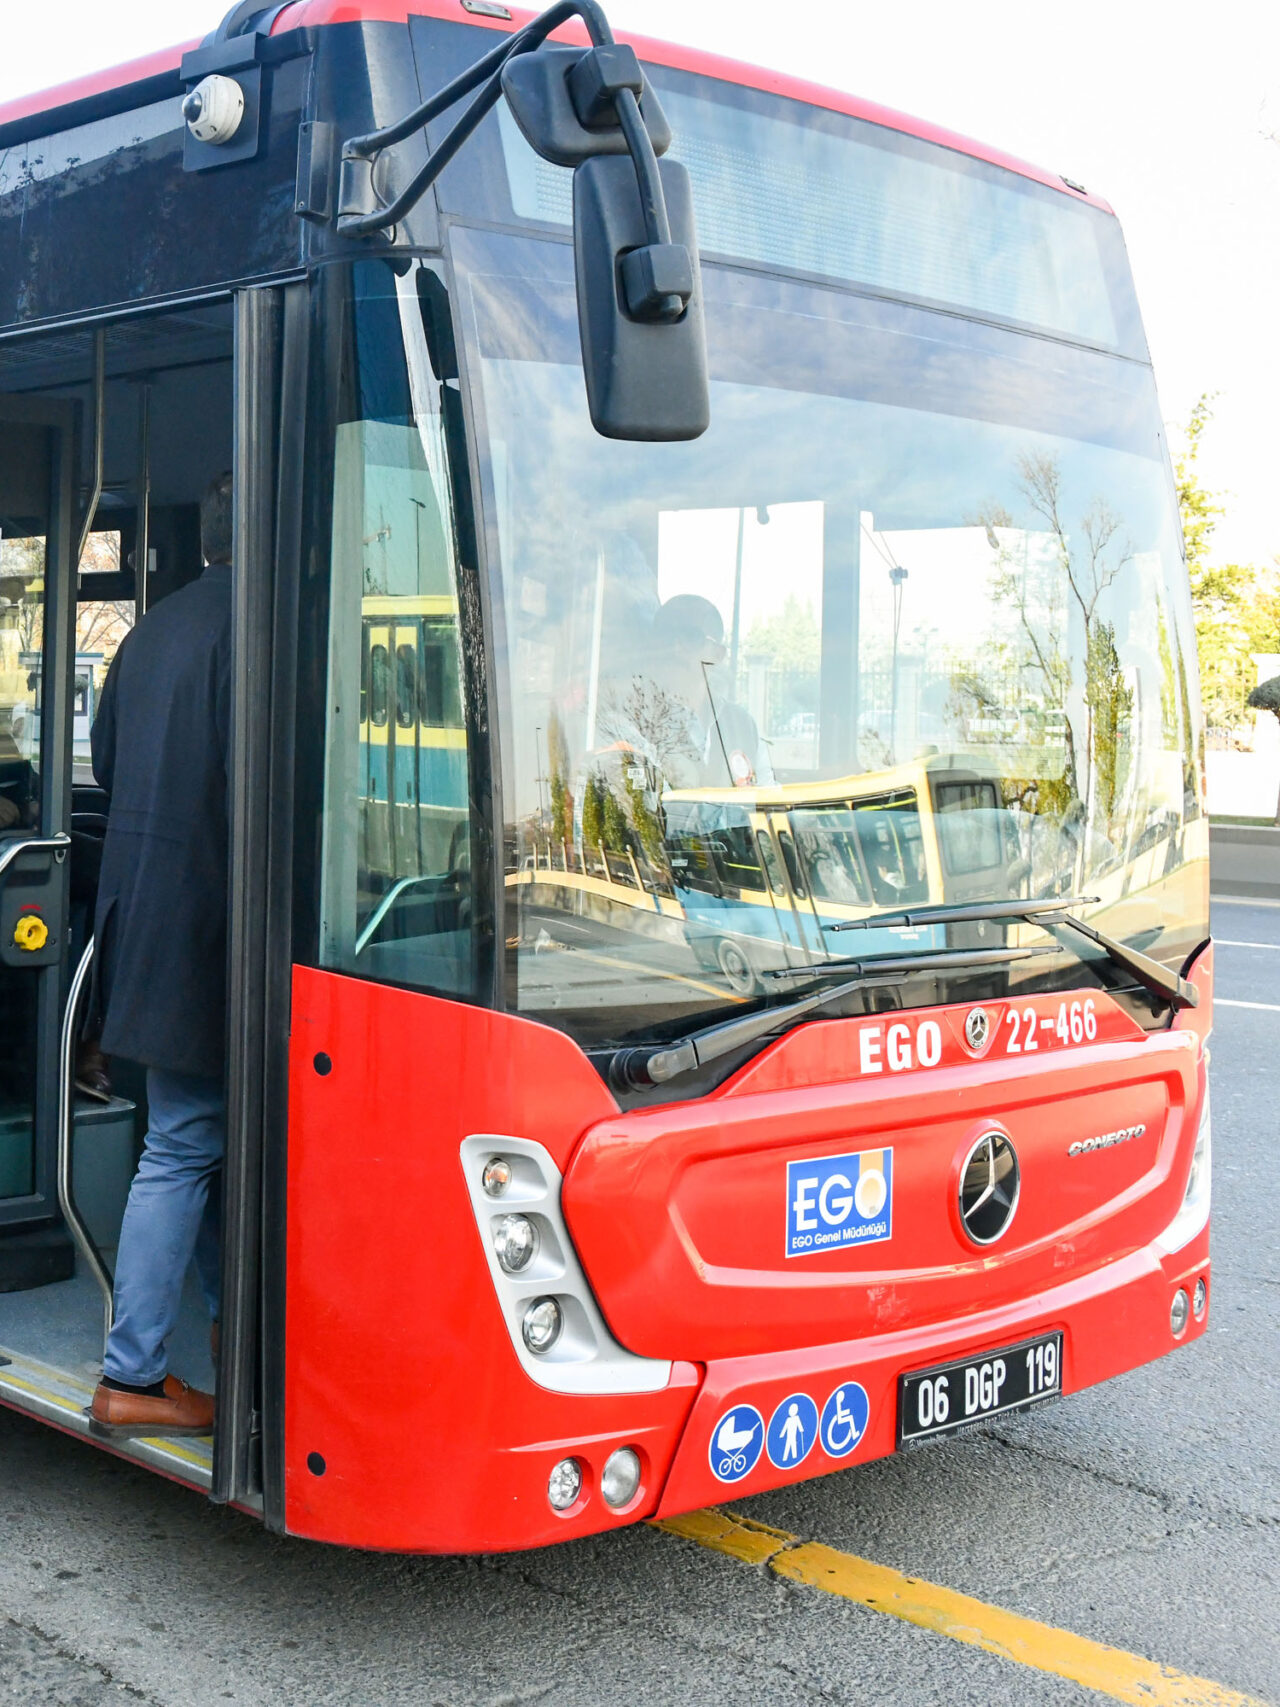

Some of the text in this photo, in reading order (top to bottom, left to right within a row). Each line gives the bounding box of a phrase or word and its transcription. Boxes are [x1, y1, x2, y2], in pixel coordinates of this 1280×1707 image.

[859, 998, 1098, 1074] EGO 22-466
[1068, 1124, 1146, 1157] CONECTO
[793, 1169, 887, 1231] EGO
[792, 1222, 887, 1249] EGO Genel Müdürlüğü
[918, 1342, 1056, 1428] 06 DGP 119
